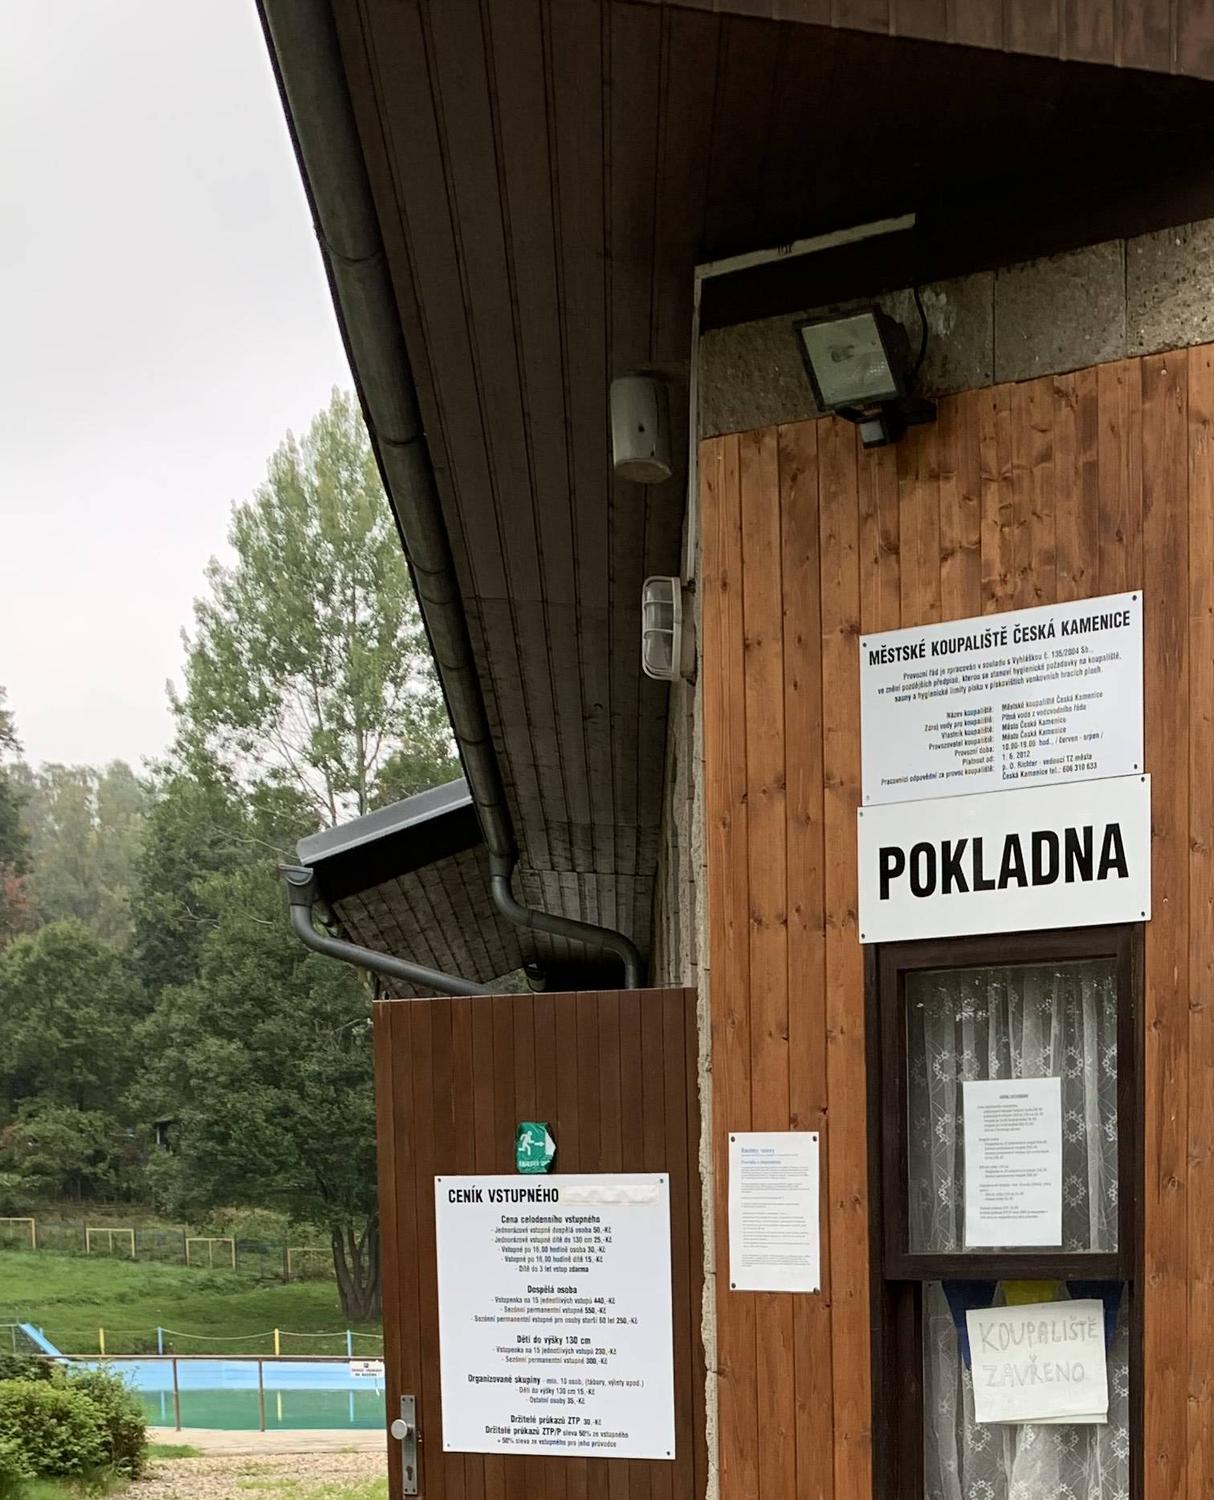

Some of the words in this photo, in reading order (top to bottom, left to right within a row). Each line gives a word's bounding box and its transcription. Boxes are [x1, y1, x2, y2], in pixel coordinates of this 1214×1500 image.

[868, 639, 925, 665] MĚSTSKÉ
[931, 626, 1007, 656] KOUPALIŠTĚ
[1013, 618, 1055, 643] ČESKÁ
[1061, 609, 1130, 636] KAMENICE
[1002, 770, 1018, 779] Česká
[1020, 767, 1047, 777] Kamenice
[879, 823, 1129, 900] POKLADNA
[448, 1184, 483, 1203] CENÍK
[487, 1184, 559, 1202] VSTUPNÉHO
[501, 1215, 517, 1223] Cena
[520, 1214, 562, 1223] celodenního
[564, 1214, 600, 1224] vstupného
[527, 1284, 554, 1294] Dospělá
[556, 1285, 577, 1293] osoba
[516, 1335, 530, 1343] Děti
[533, 1335, 541, 1343] do
[544, 1335, 562, 1345] výšky
[565, 1335, 577, 1344] 130
[979, 1315, 1099, 1353] KOUPALIŠTĚ
[982, 1353, 1085, 1387] ZAVŘENO
[467, 1374, 511, 1384] Organizované
[514, 1375, 540, 1385] skupiny
[510, 1415, 536, 1423] Držitelé
[567, 1416, 580, 1425] ZTP
[485, 1425, 510, 1434] Držitelé
[541, 1427, 561, 1437] ZTP/P
